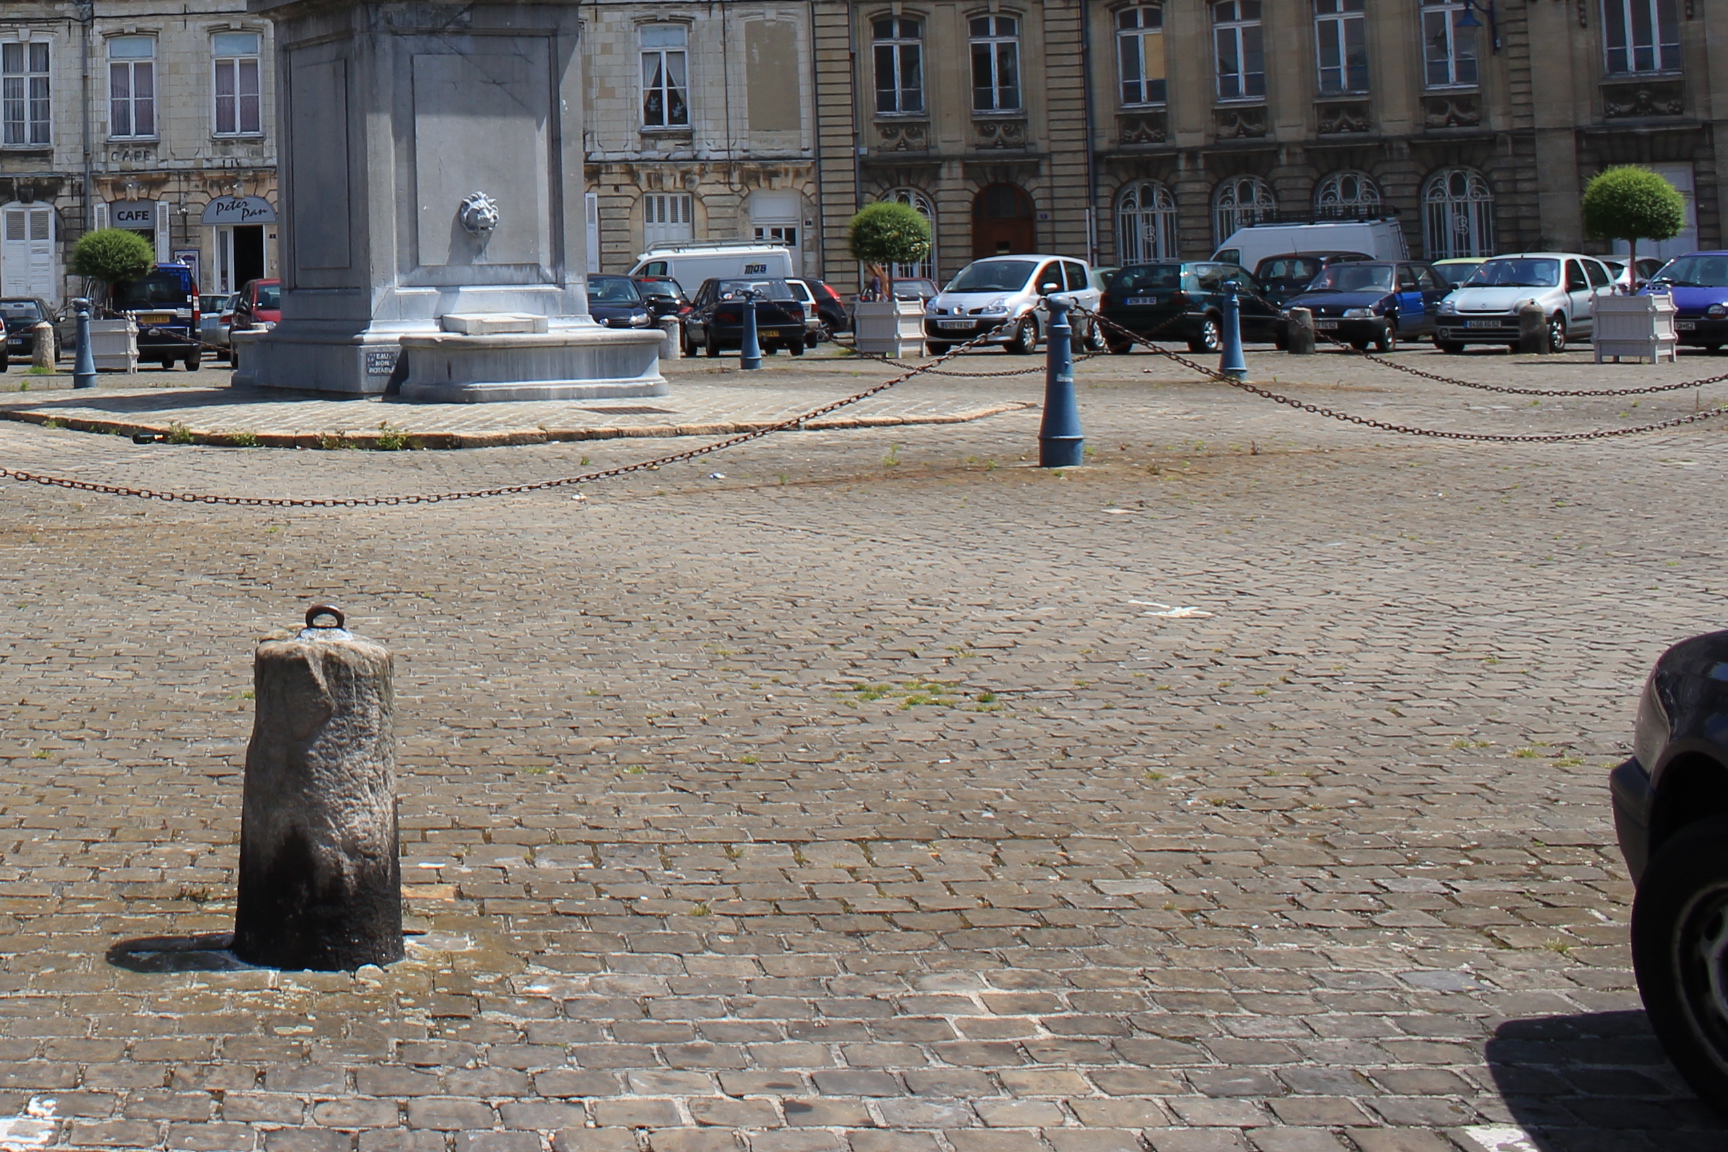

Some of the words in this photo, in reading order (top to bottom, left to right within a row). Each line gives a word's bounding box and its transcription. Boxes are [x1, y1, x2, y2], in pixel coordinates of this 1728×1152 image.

[216, 199, 249, 216] Peter
[117, 210, 149, 221] CAFE
[241, 208, 268, 221] Pan
